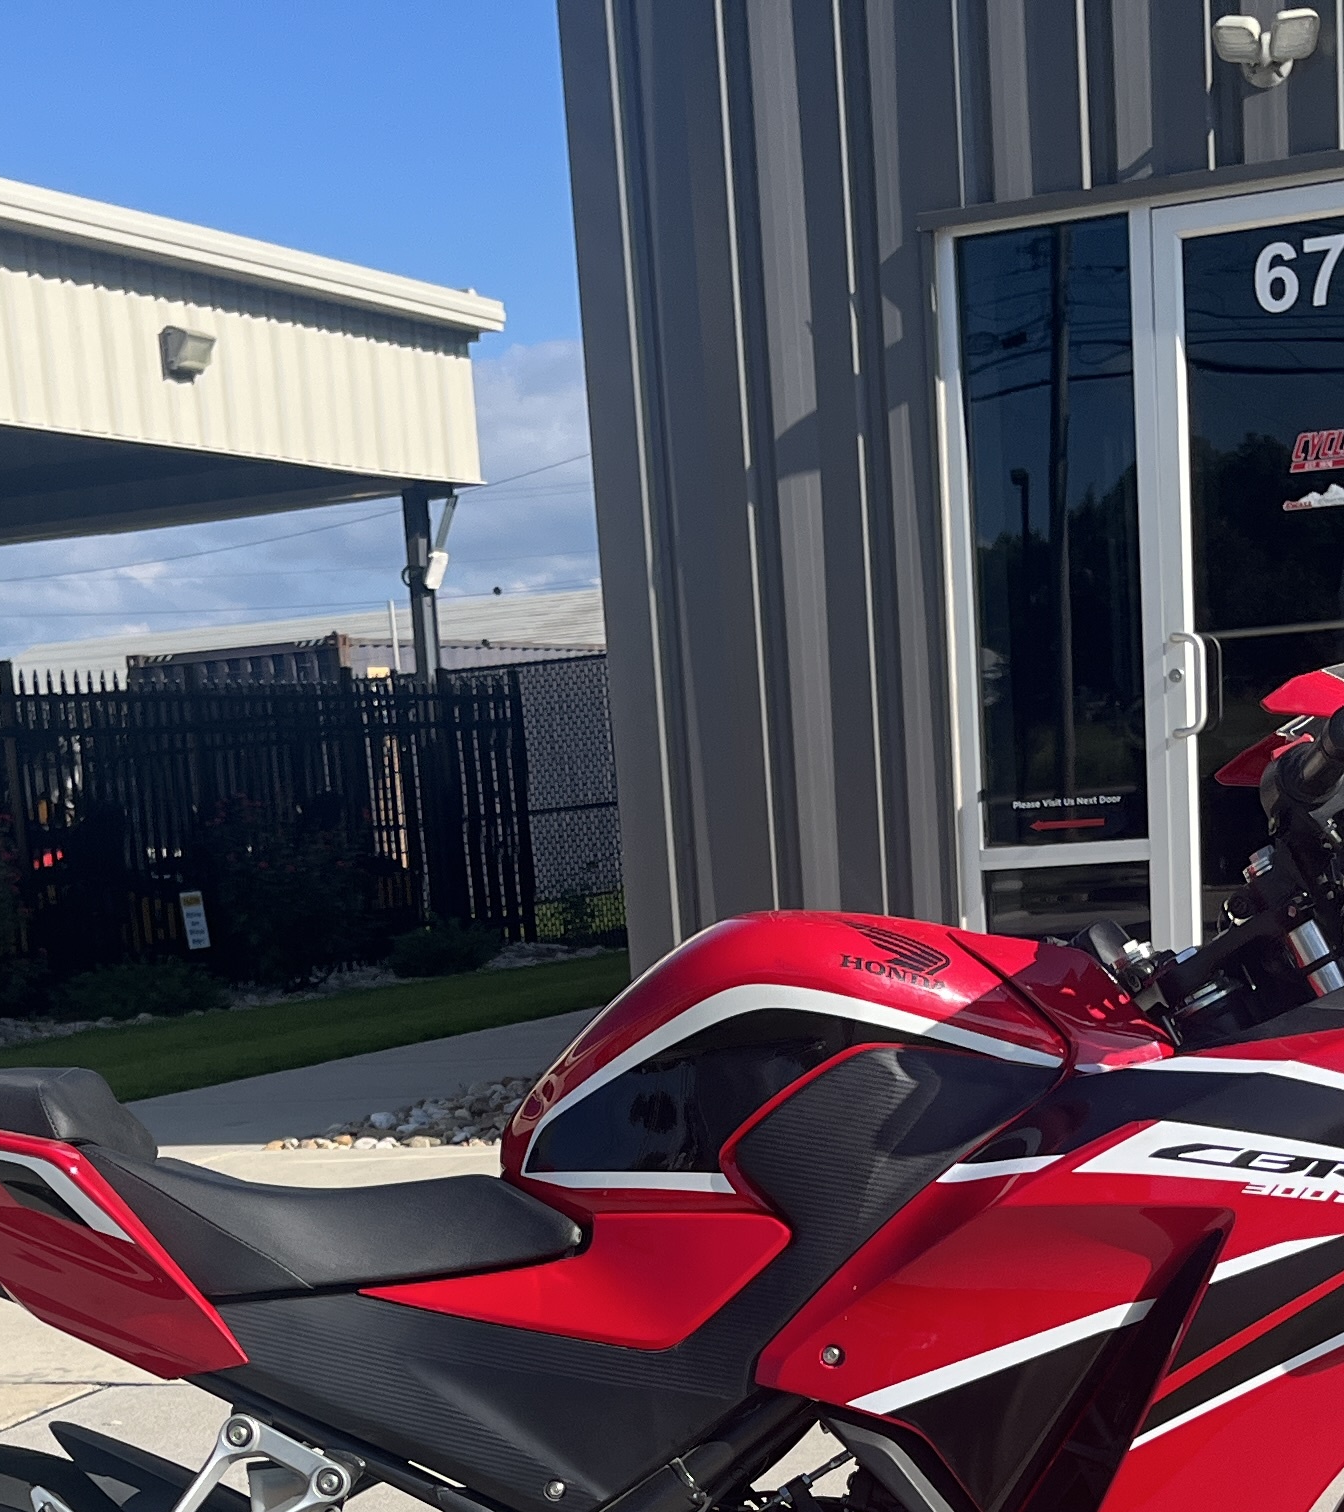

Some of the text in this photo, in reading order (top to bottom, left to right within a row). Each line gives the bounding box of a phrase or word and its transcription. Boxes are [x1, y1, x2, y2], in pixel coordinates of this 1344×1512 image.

[1012, 795, 1122, 810] Please Visit Us Next Door
[840, 954, 946, 990] HONDA
